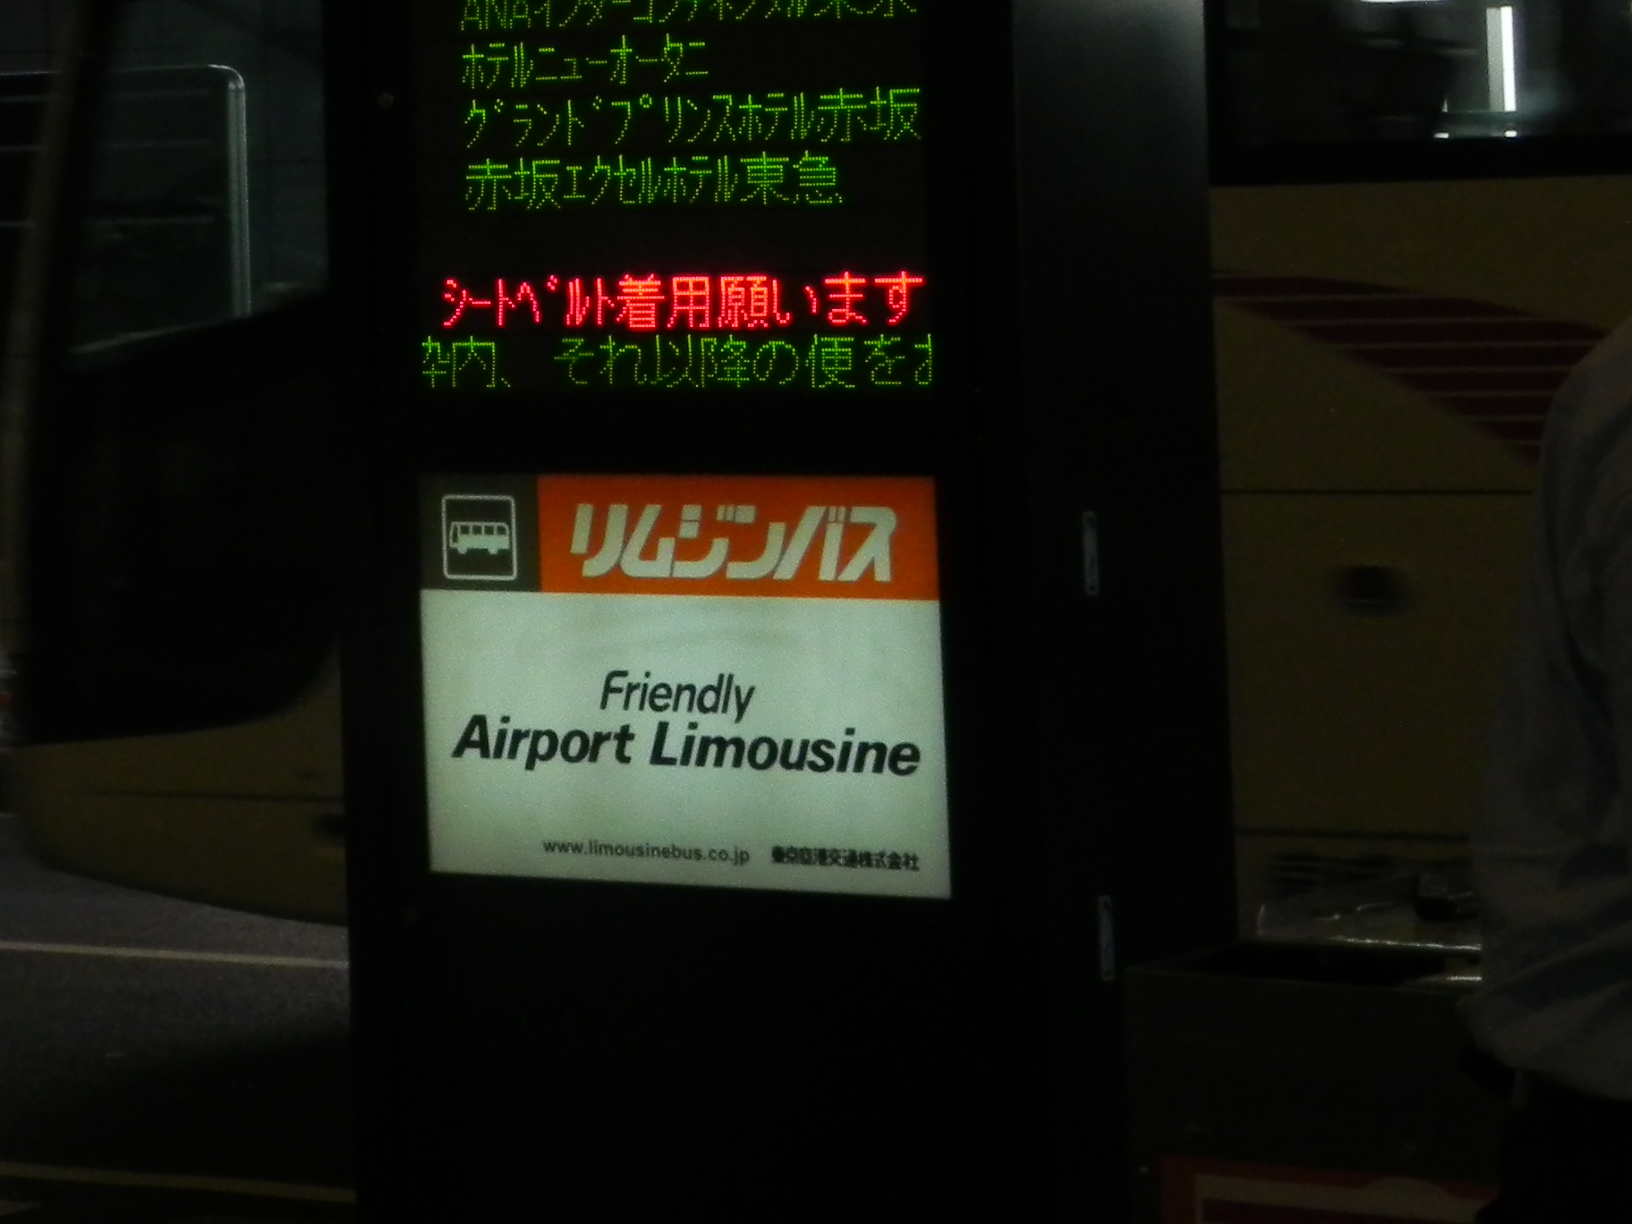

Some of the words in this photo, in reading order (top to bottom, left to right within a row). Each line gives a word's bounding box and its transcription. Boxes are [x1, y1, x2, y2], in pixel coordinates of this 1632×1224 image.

[571, 504, 898, 583] リムジンバス
[600, 670, 755, 723] Friendly
[452, 714, 635, 770] Airport
[649, 720, 921, 777] Limousine
[542, 837, 750, 866] www.limousinebus.co.jp
